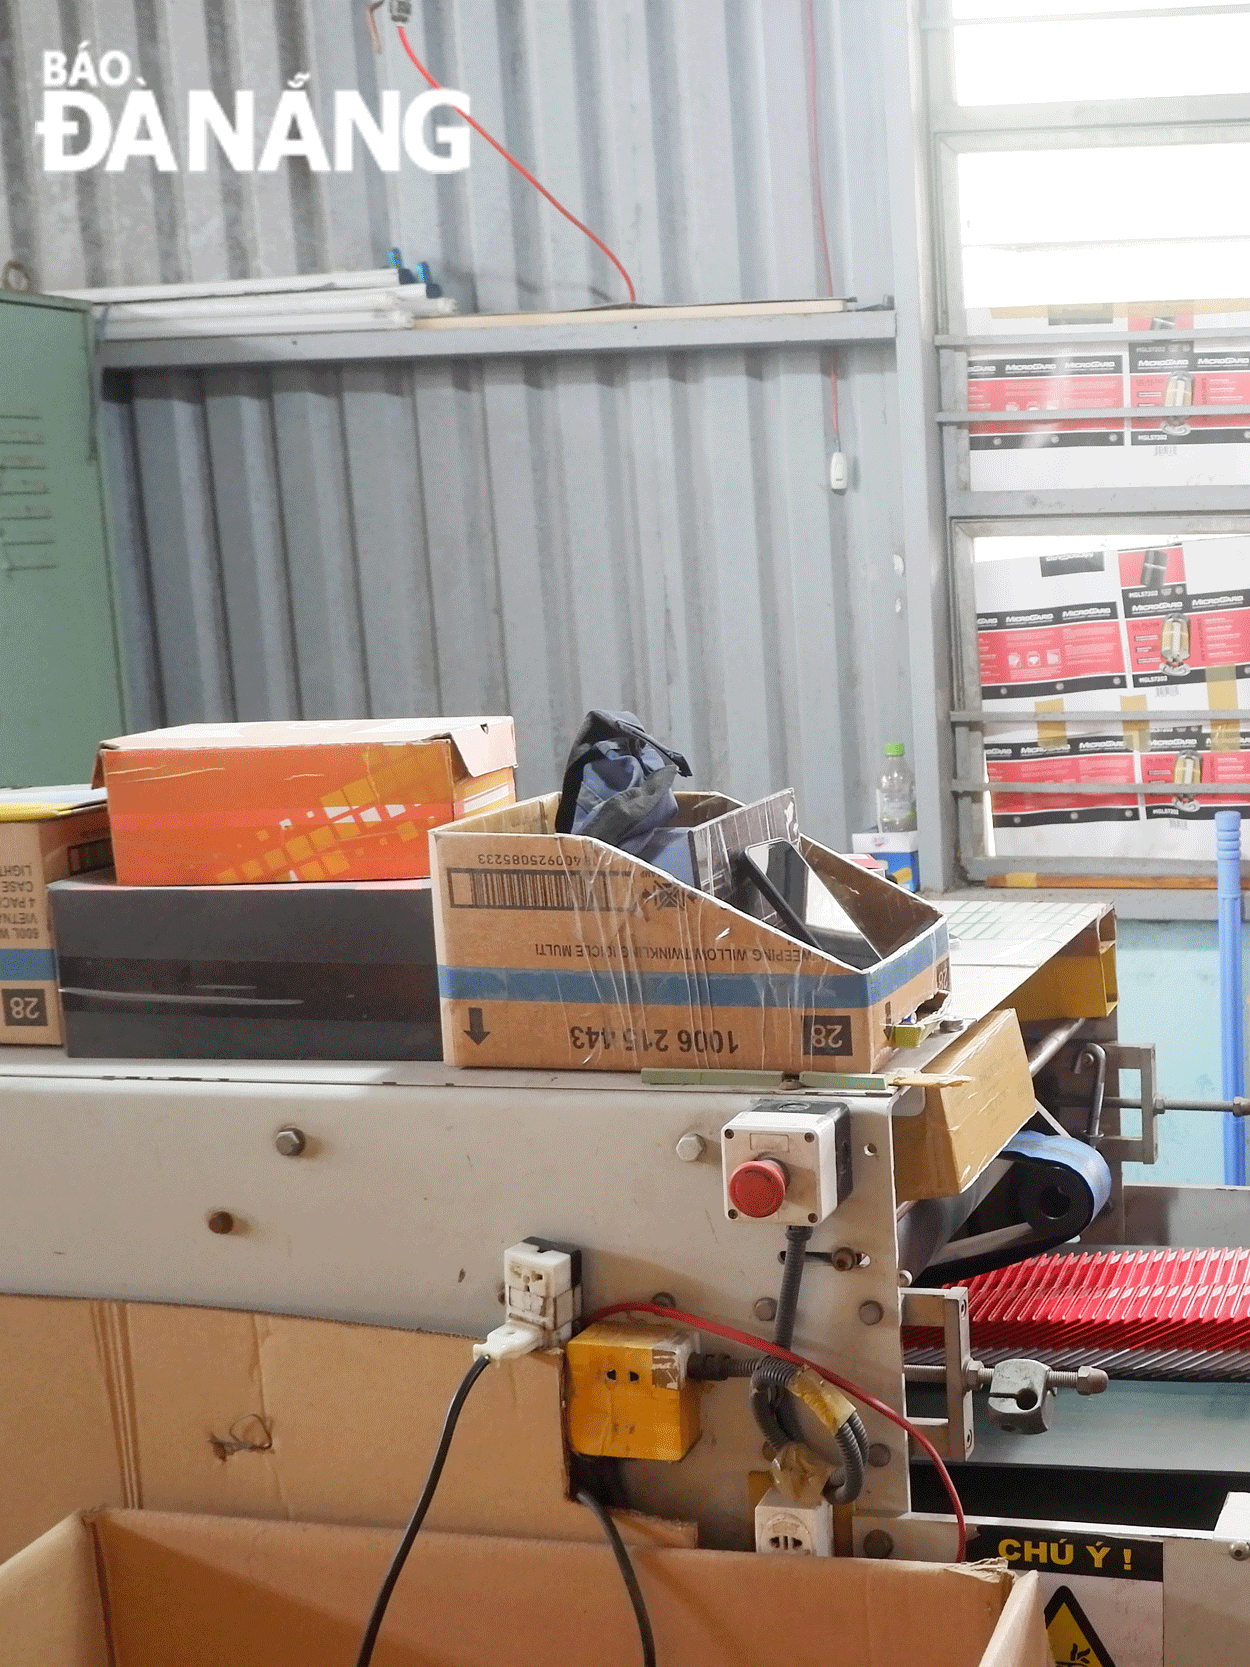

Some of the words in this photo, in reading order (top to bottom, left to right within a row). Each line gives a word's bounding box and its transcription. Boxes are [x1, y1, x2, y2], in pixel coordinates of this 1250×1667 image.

[2, 881, 34, 893] CASE
[0, 897, 27, 908] PAC
[535, 943, 572, 957] MULTI
[9, 997, 40, 1019] 28
[569, 1025, 616, 1050] 443
[623, 1027, 668, 1052] 215
[677, 1028, 738, 1054] 1006
[811, 1024, 843, 1049] 28
[998, 1538, 1075, 1566] CHÚ
[1086, 1541, 1112, 1568] Ý
